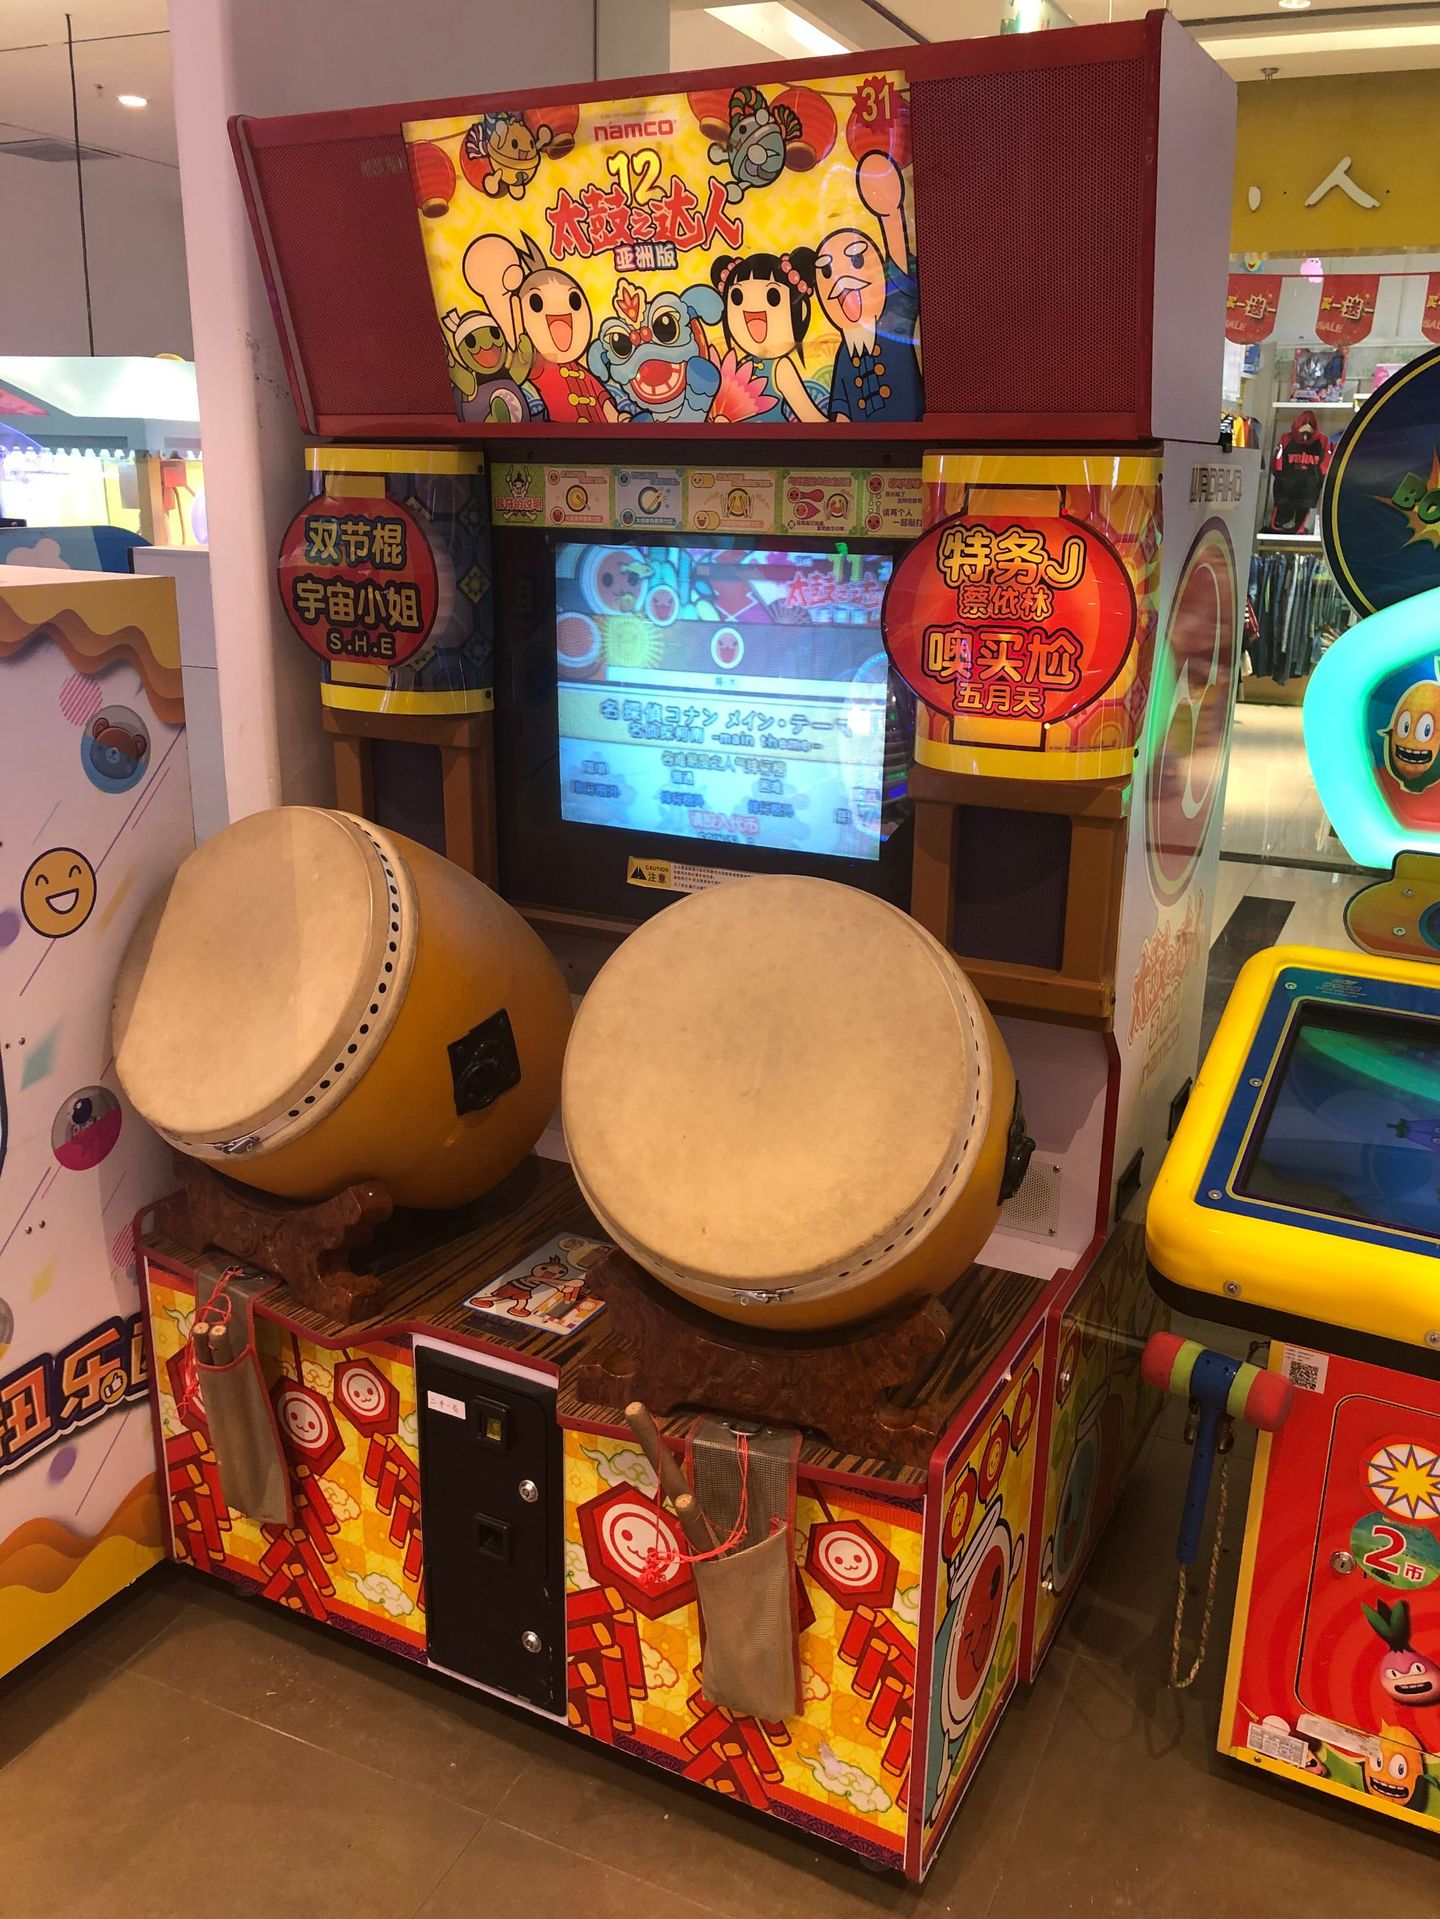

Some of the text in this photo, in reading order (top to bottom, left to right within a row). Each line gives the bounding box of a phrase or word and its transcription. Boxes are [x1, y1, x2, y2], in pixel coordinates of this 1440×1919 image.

[861, 84, 891, 122] 31
[593, 119, 674, 142] namco
[607, 148, 668, 206] 12
[546, 175, 743, 259] 太鼓之达人
[614, 244, 678, 271] 亚洲版
[307, 518, 404, 566] 双节棍
[941, 529, 1084, 586] 特务J
[294, 578, 420, 629] 宇宙小姐
[961, 588, 1052, 619] 蔡依林
[926, 628, 1080, 686] 噢买尬
[956, 684, 1044, 715] 五月天
[645, 864, 669, 873] CAUTION
[648, 872, 667, 884] 注意
